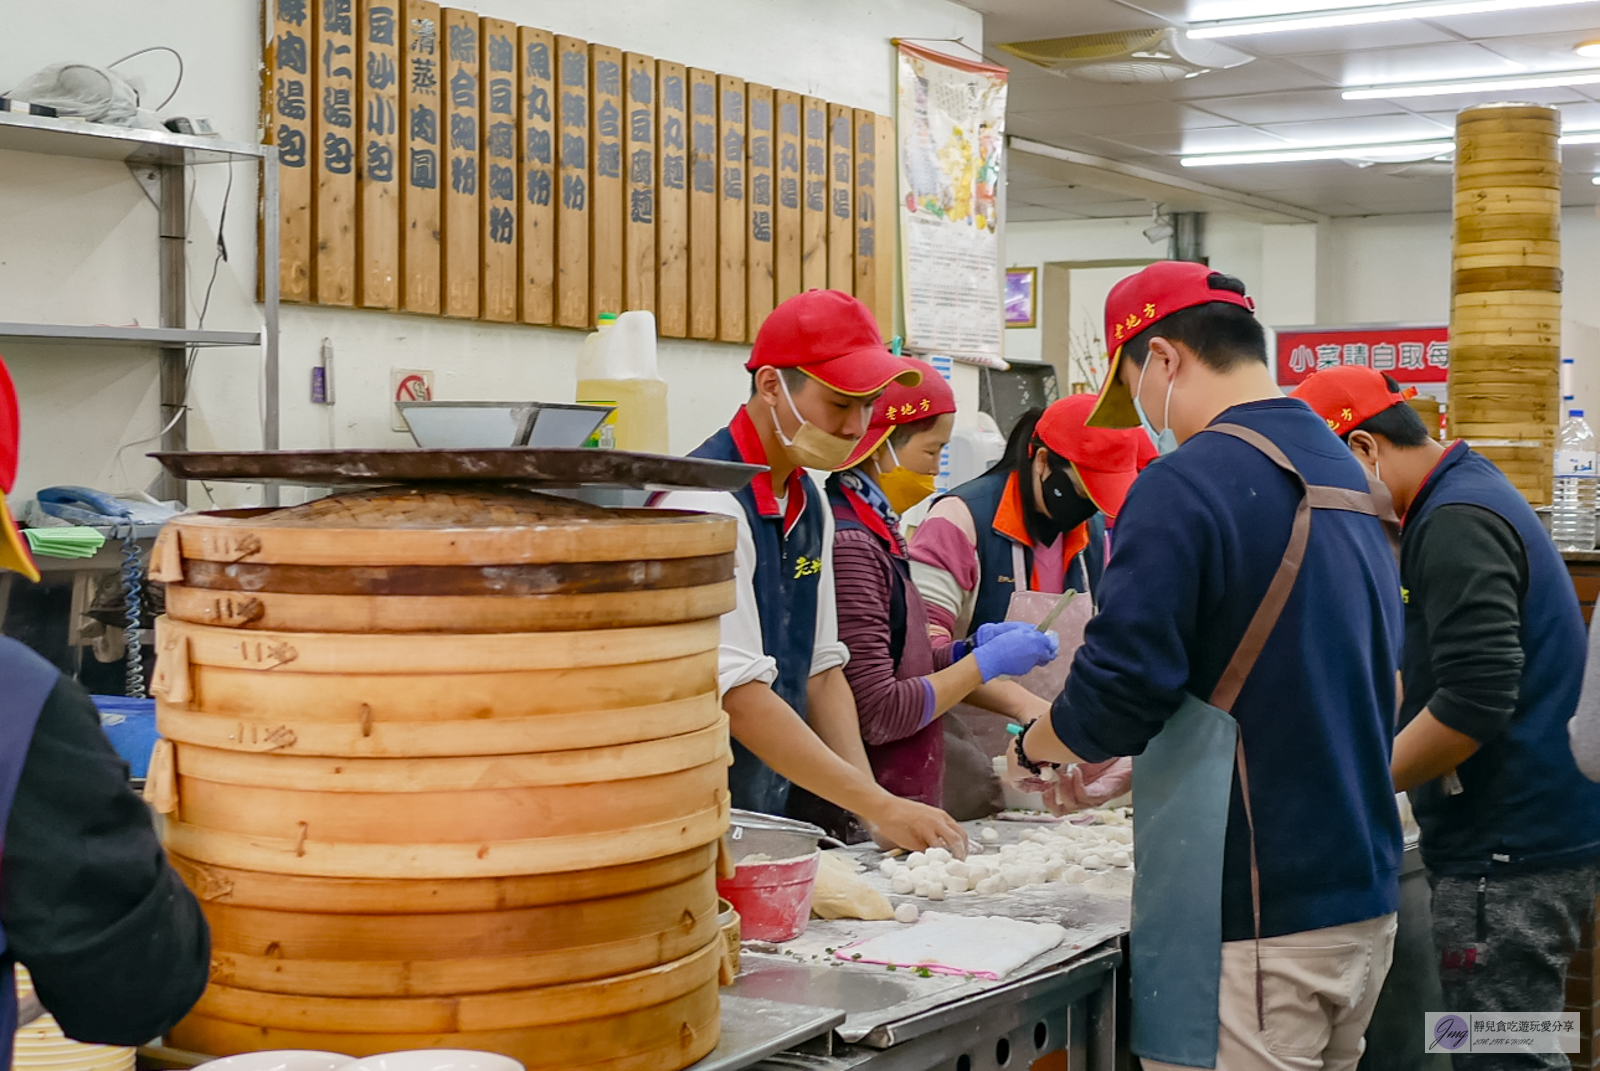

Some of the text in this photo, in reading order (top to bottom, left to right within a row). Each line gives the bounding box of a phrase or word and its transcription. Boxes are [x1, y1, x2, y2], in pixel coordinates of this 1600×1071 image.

[324, 0, 353, 173] 蝦仁湯包
[368, 7, 395, 182] 豆沙小包
[411, 20, 437, 188] 清蒸肉圓
[1113, 303, 1156, 340] 老地方
[1289, 341, 1448, 373] 小菜請自取每
[885, 398, 931, 421] 老地方
